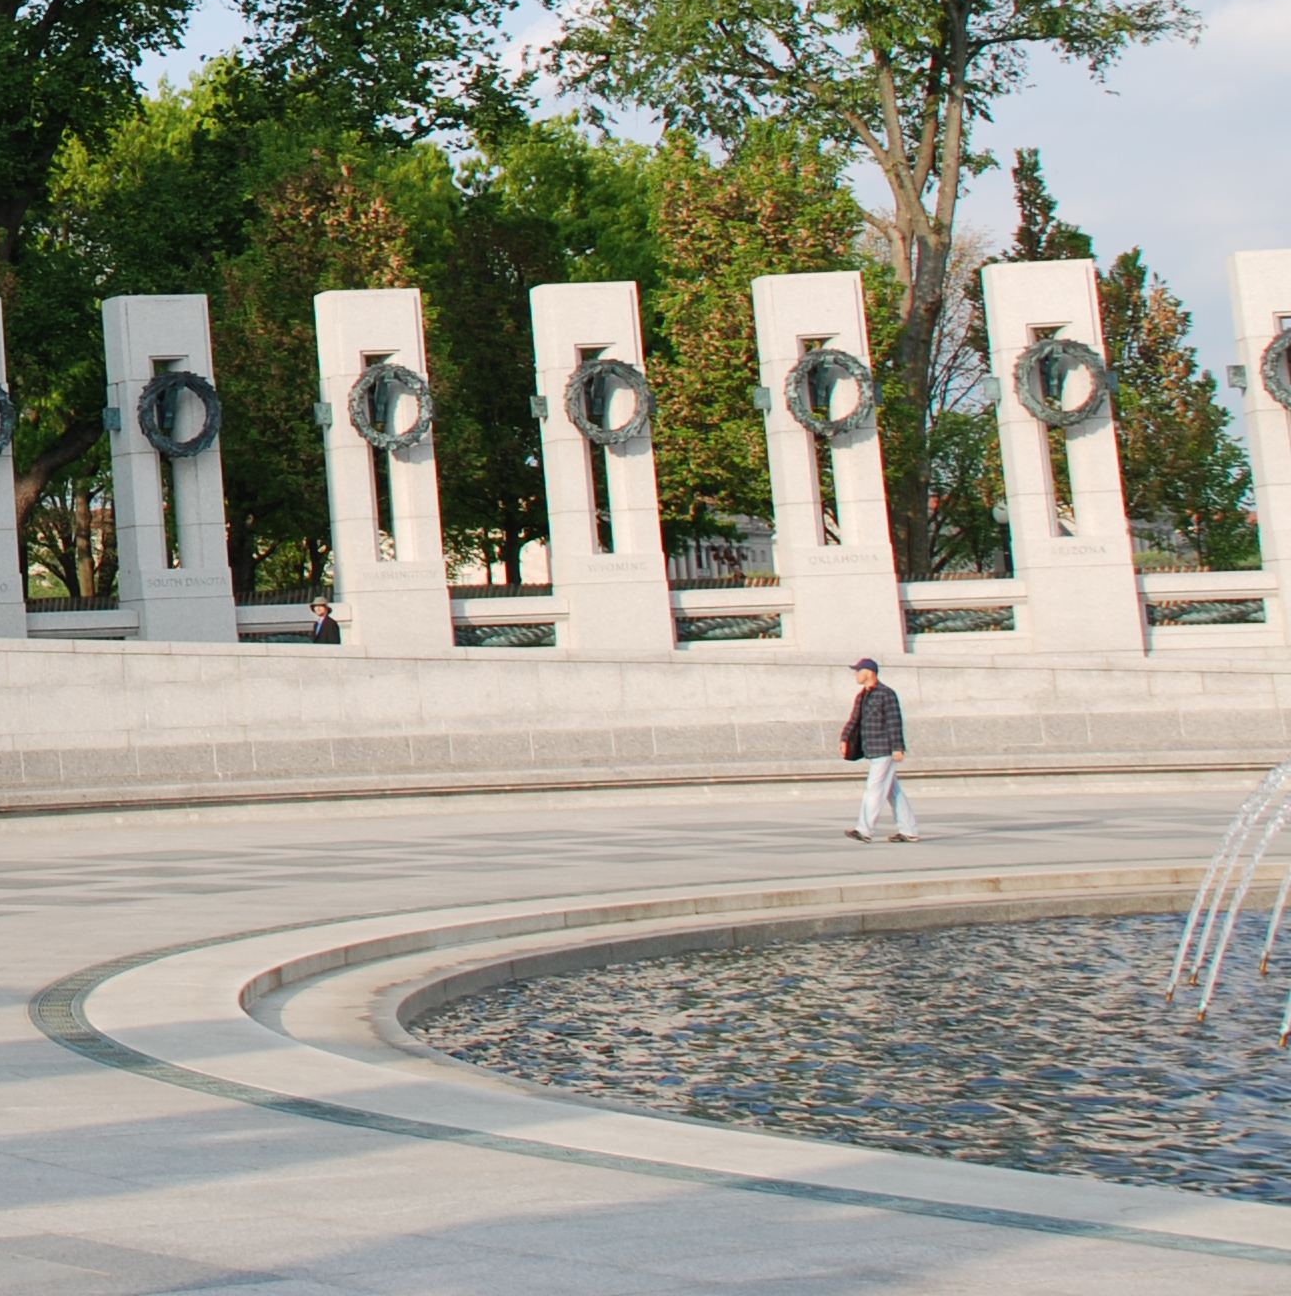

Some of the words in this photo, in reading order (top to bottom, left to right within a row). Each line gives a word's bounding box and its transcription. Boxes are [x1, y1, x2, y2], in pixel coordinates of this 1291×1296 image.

[1050, 545, 1107, 556] ARIZONA
[808, 554, 878, 565] OKLAHOMA
[587, 562, 647, 572] WYOMING
[147, 578, 182, 588] SOUTH
[185, 576, 226, 587] DAKOTA
